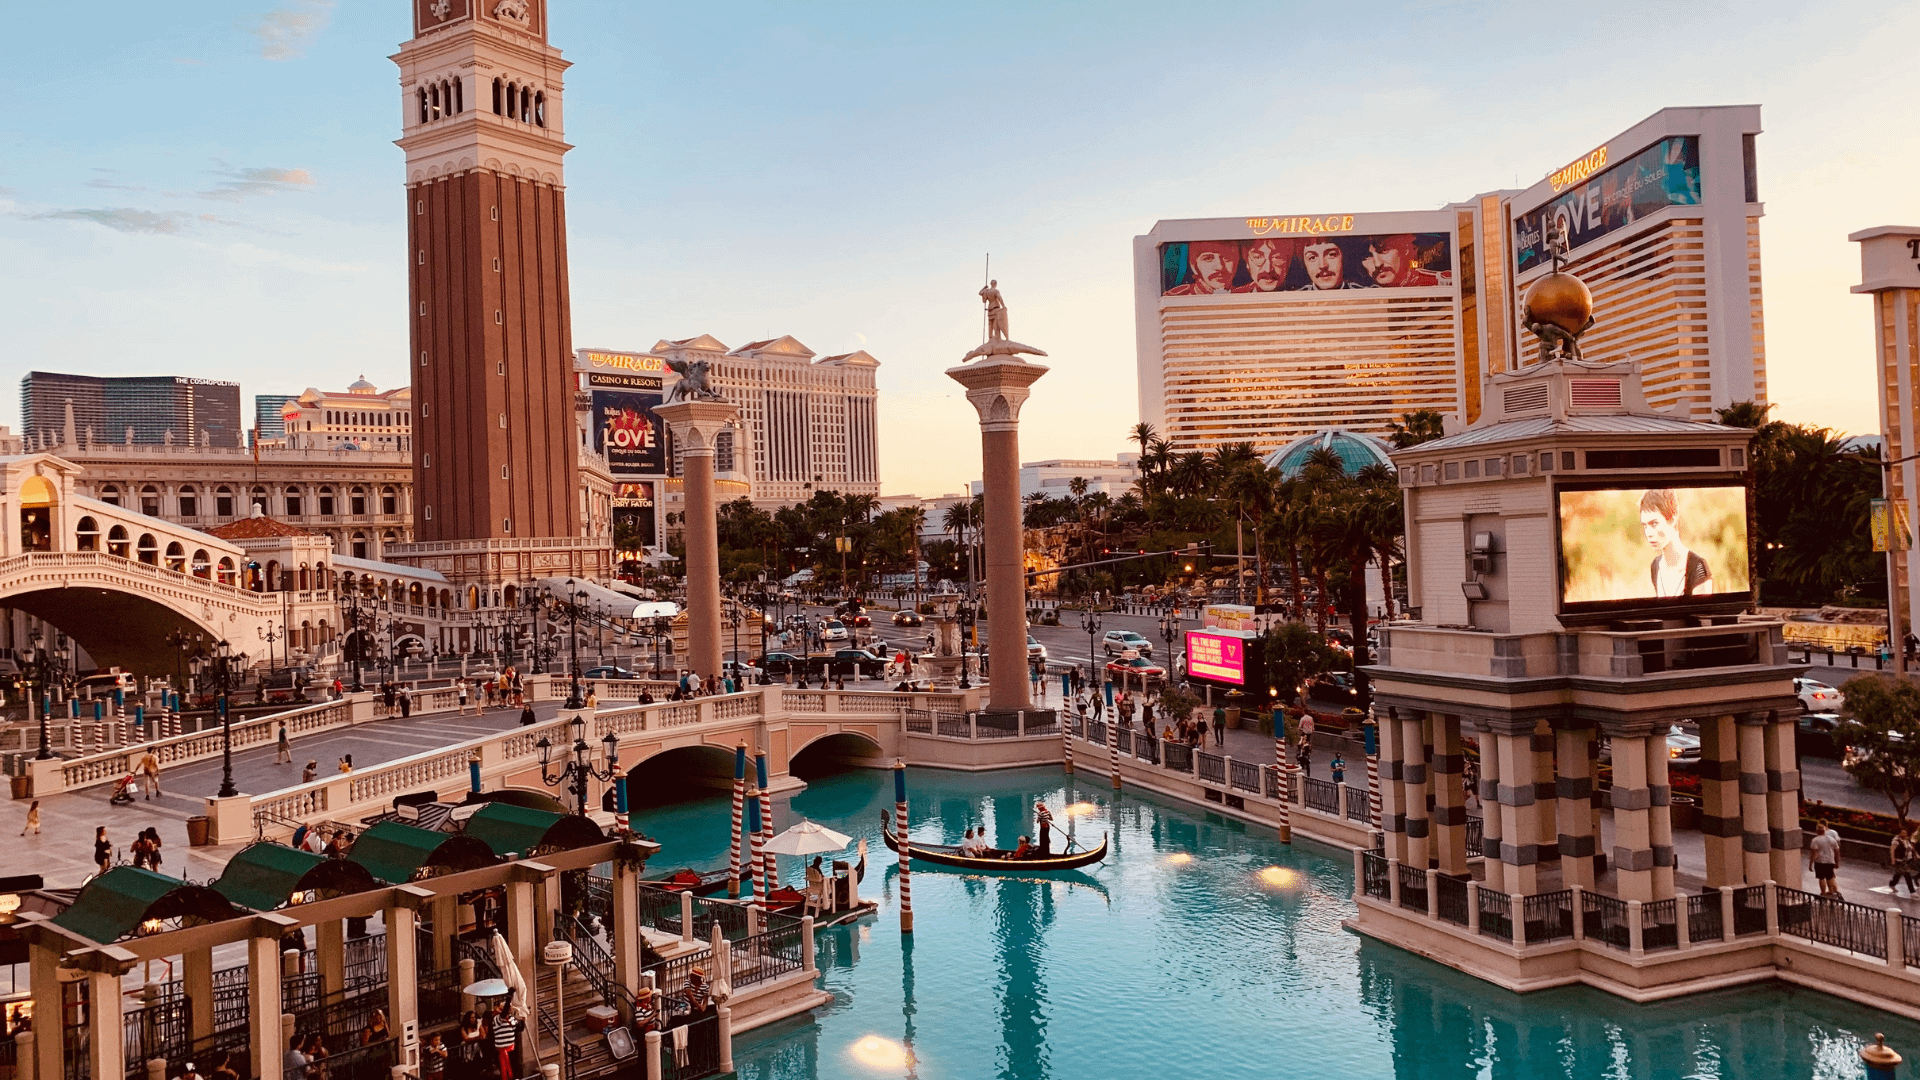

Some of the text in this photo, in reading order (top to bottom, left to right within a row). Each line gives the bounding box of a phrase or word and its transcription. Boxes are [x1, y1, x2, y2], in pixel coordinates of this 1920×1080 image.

[1554, 146, 1607, 192] MIRAGE
[1635, 180, 1644, 190] DU
[1246, 216, 1354, 235] THE MIRAGE
[1541, 186, 1602, 252] LOVE
[587, 353, 662, 372] THE MIRAGE
[190, 378, 240, 387] COSMOPOLITAN
[591, 375, 621, 384] CASINO
[630, 379, 662, 387] RESORT
[604, 428, 656, 447] LOVE
[1199, 637, 1210, 647] THE
[1210, 639, 1221, 648] BEST
